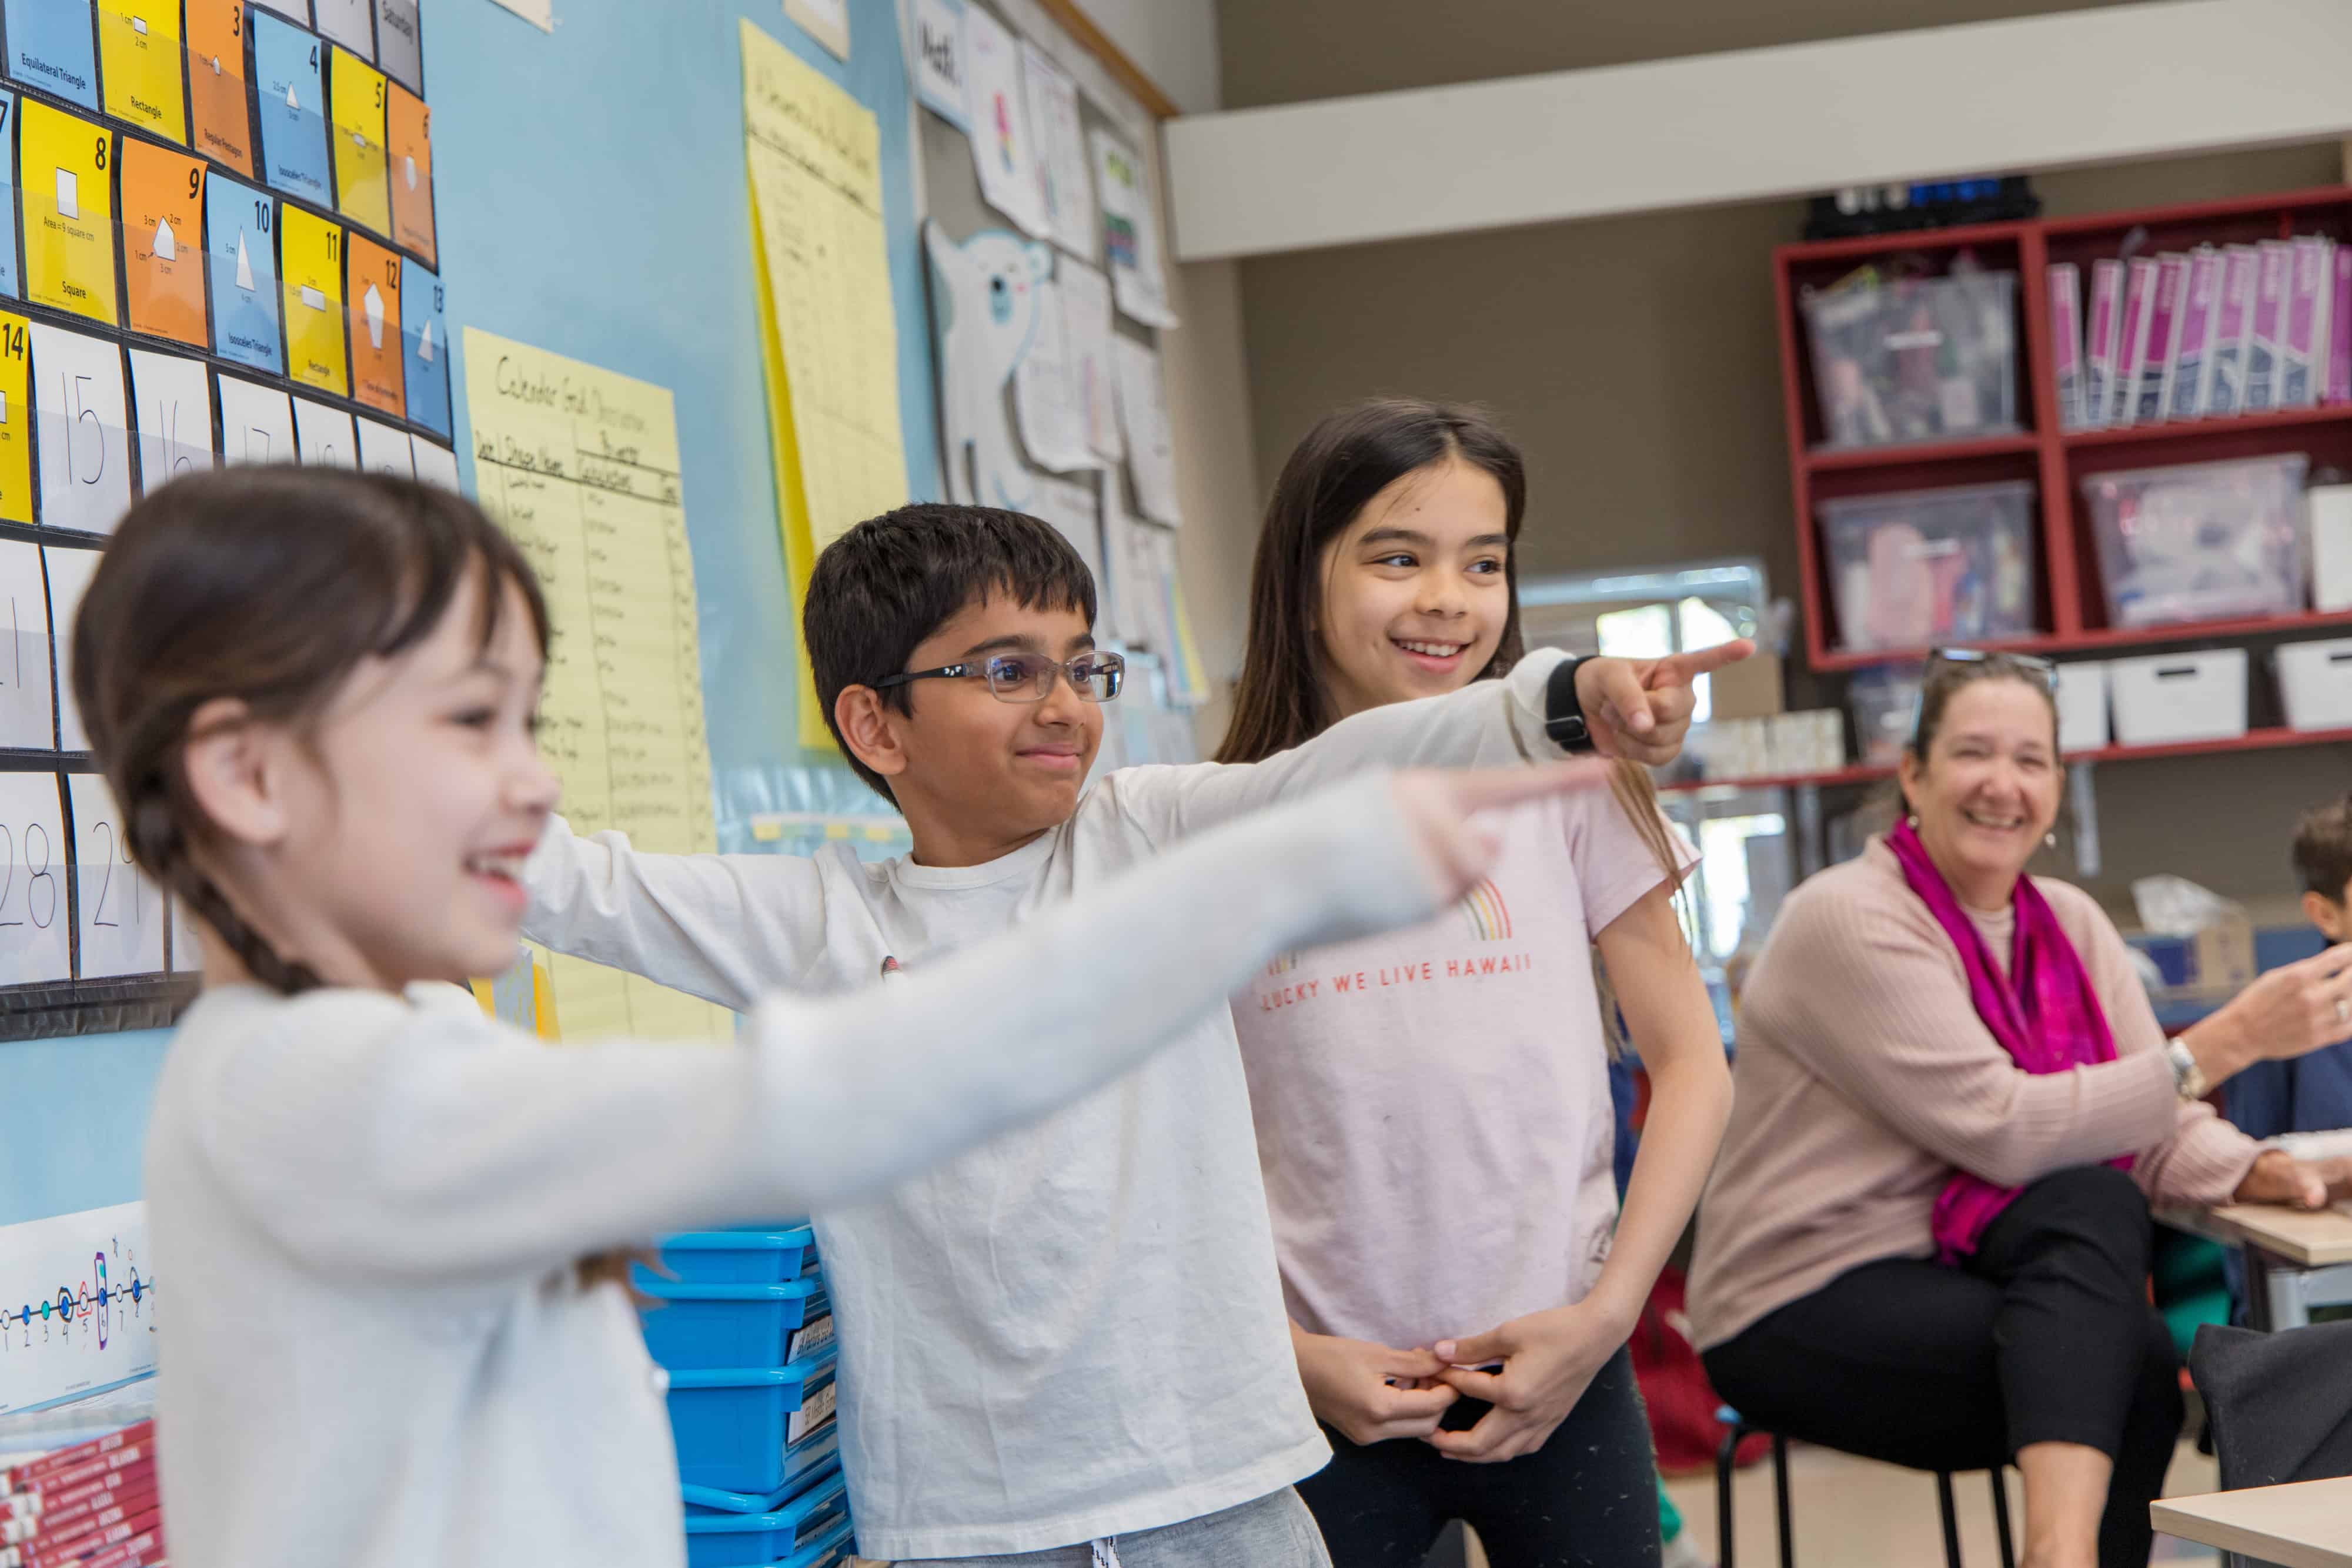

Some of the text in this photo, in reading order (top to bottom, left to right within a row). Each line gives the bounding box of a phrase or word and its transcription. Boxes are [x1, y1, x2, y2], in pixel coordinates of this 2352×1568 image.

[233, 6, 240, 36] 3
[22, 53, 58, 77] Equilateral
[59, 68, 86, 90] Triangle
[309, 45, 318, 74] 4
[131, 95, 162, 119] Rectangle
[375, 82, 382, 108] 5
[95, 137, 106, 170] 8
[189, 168, 200, 199] 9
[44, 216, 56, 230] Area
[255, 200, 269, 233] 10
[326, 231, 338, 262] 11
[62, 280, 86, 299] Square
[386, 259, 397, 289] 12
[433, 285, 443, 314] 13
[3, 323, 24, 361] 14
[62, 372, 105, 485] 15
[0, 597, 20, 688] 1
[0, 823, 56, 929] 28
[1261, 954, 1531, 1012] LUCKY WE LIVE HAWAII
[24, 1329, 31, 1348] 2
[44, 1324, 49, 1343] 3
[62, 1324, 69, 1345] 4
[82, 1318, 88, 1333] 5
